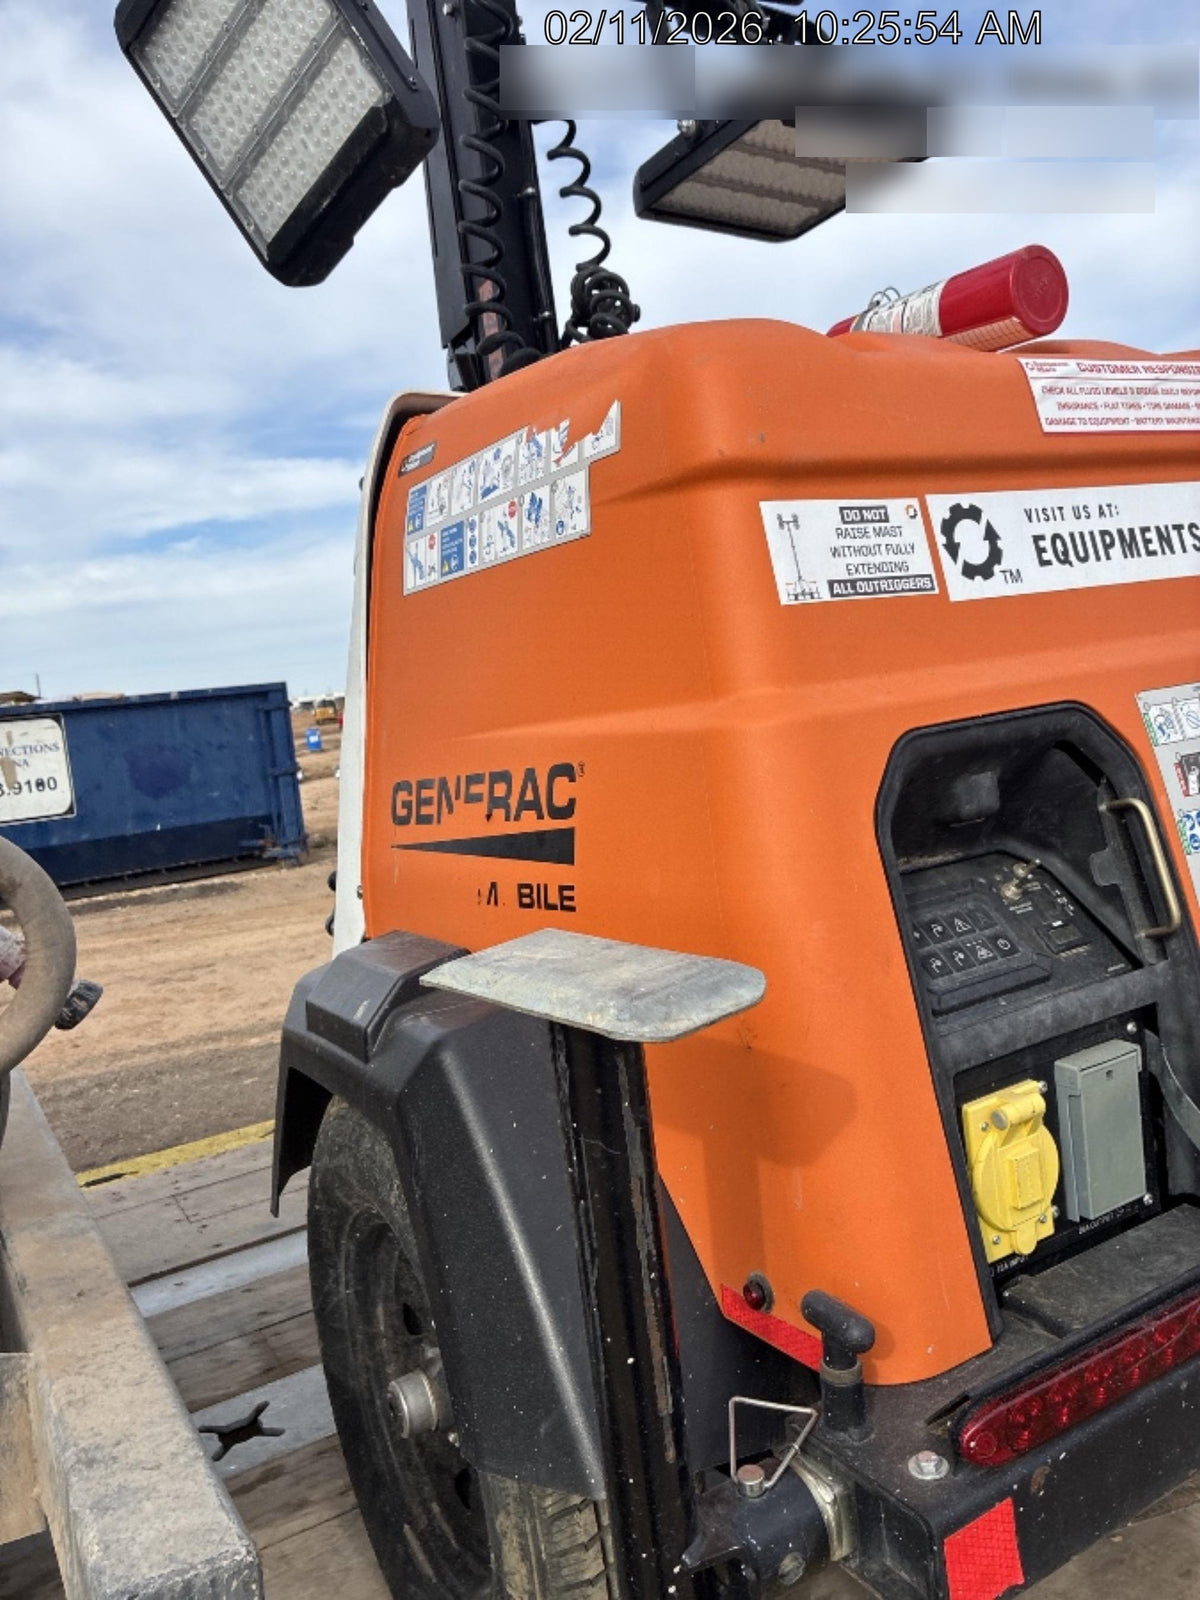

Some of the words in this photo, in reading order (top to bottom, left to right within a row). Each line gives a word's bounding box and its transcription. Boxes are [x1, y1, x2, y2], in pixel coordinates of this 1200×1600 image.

[1076, 362, 1142, 375] CUSTOMER
[843, 510, 858, 522] DO
[863, 509, 886, 521] NOT
[1024, 506, 1066, 524] VISIT
[1072, 504, 1091, 520] US
[1098, 502, 1120, 518] AT:
[835, 527, 871, 540] RAISE
[872, 526, 902, 539] MAST
[830, 544, 883, 559] WITHOUT
[886, 543, 915, 556] FULLY
[1031, 522, 1200, 567] EQUIPMENTS
[845, 561, 909, 576] EXTENDING
[1000, 568, 1023, 584] TM
[833, 582, 854, 595] ALL
[858, 577, 932, 593] OUTRIGGERS
[391, 762, 577, 826] GENERAC
[477, 881, 577, 912] MBILE
